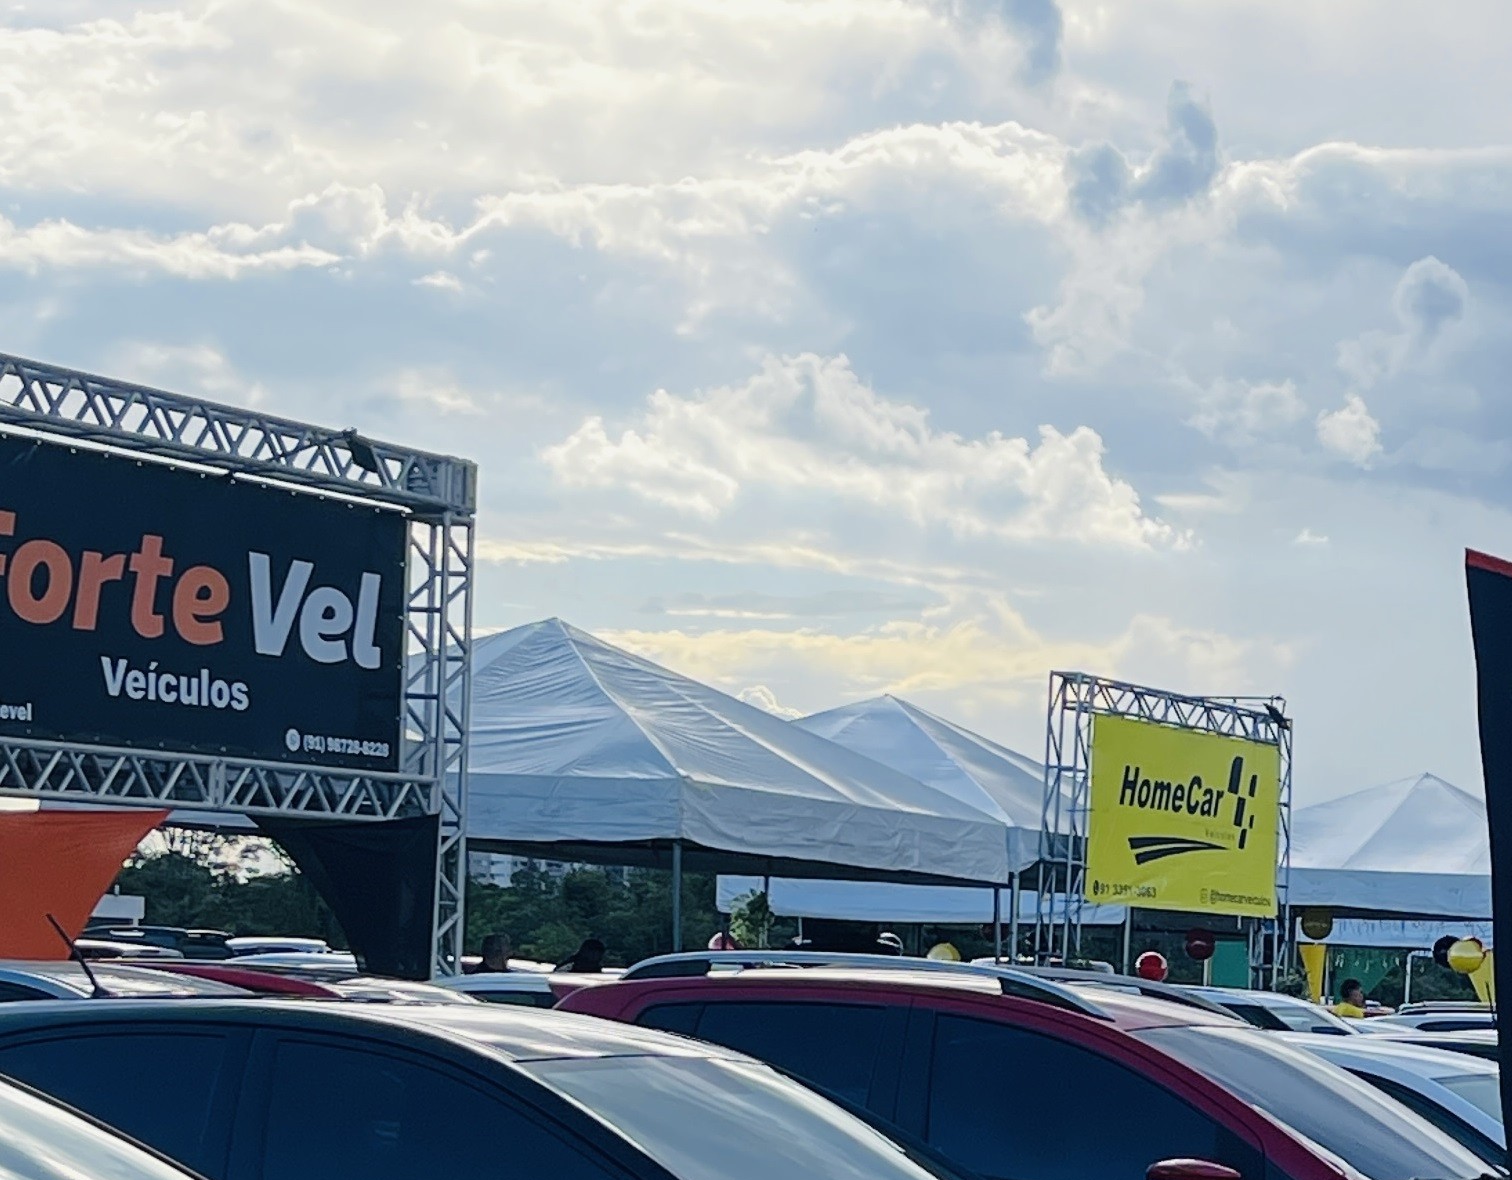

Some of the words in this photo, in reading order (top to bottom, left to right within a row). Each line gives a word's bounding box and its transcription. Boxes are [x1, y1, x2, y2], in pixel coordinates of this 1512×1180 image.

[249, 551, 381, 670] Vel
[101, 656, 249, 711] Veículos
[1119, 765, 1225, 818] HomeCar
